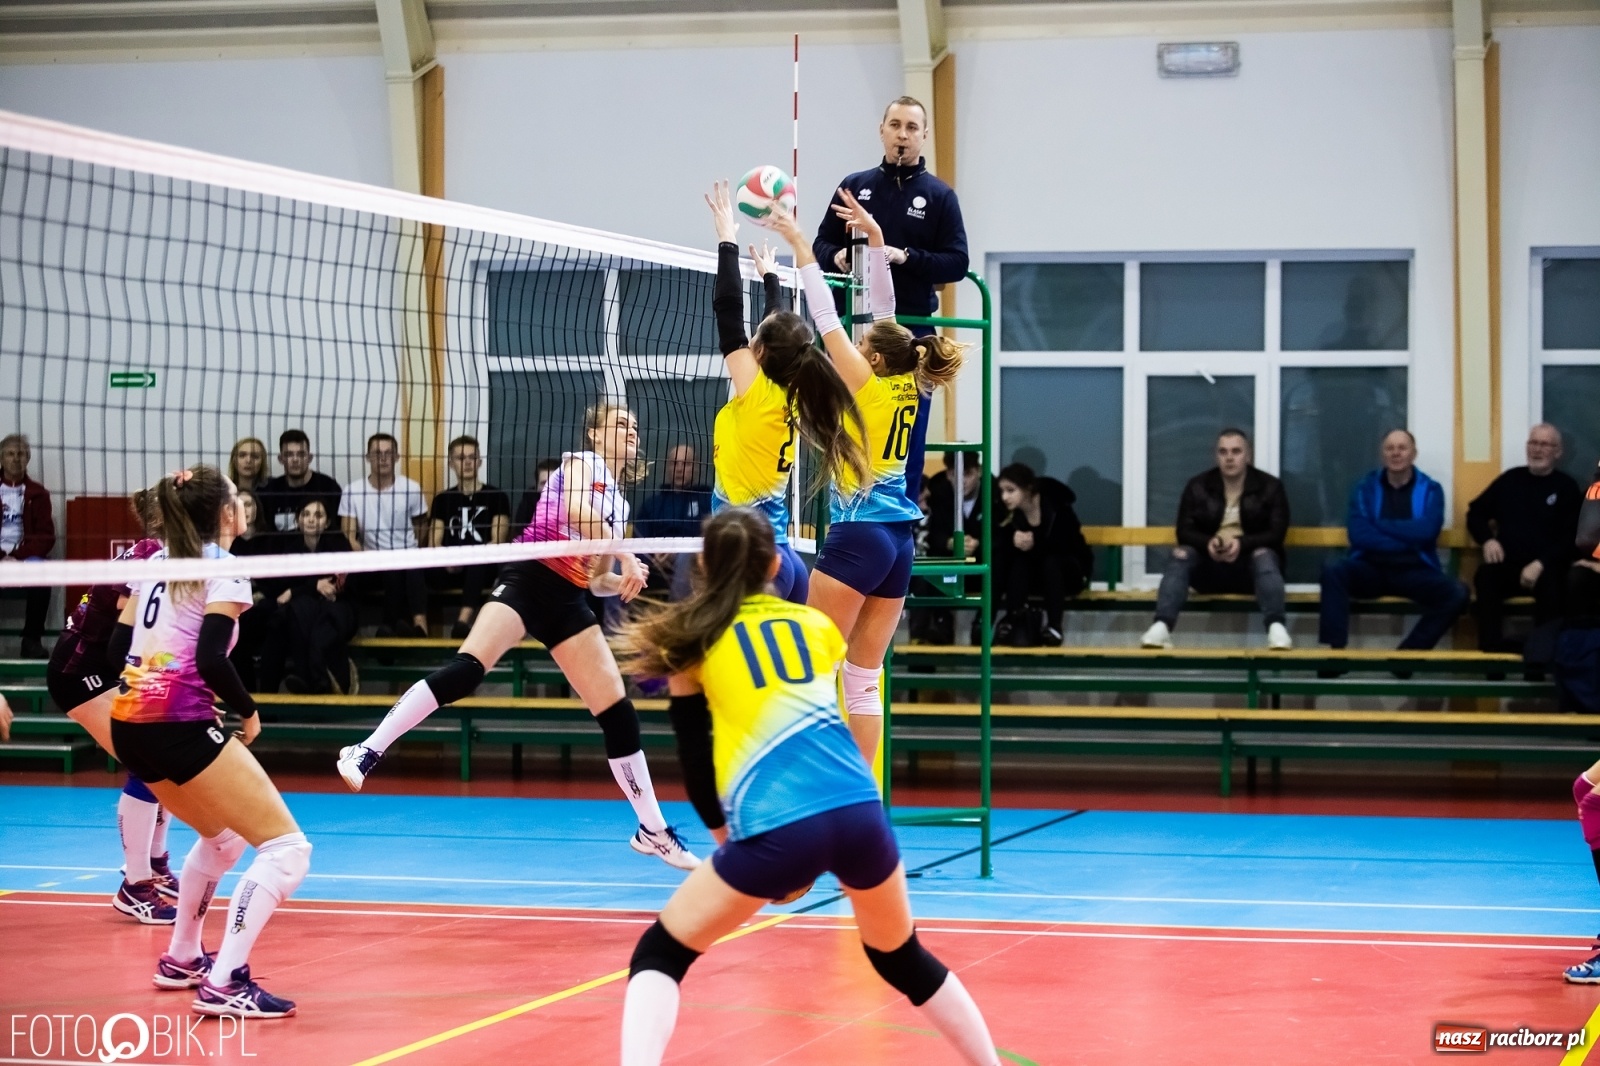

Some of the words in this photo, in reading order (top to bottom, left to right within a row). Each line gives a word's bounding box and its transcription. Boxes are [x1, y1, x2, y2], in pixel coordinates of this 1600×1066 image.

[882, 405, 916, 461] 16
[143, 580, 167, 629] 6
[734, 618, 815, 689] 10
[82, 675, 103, 690] 10
[207, 726, 224, 743] 6
